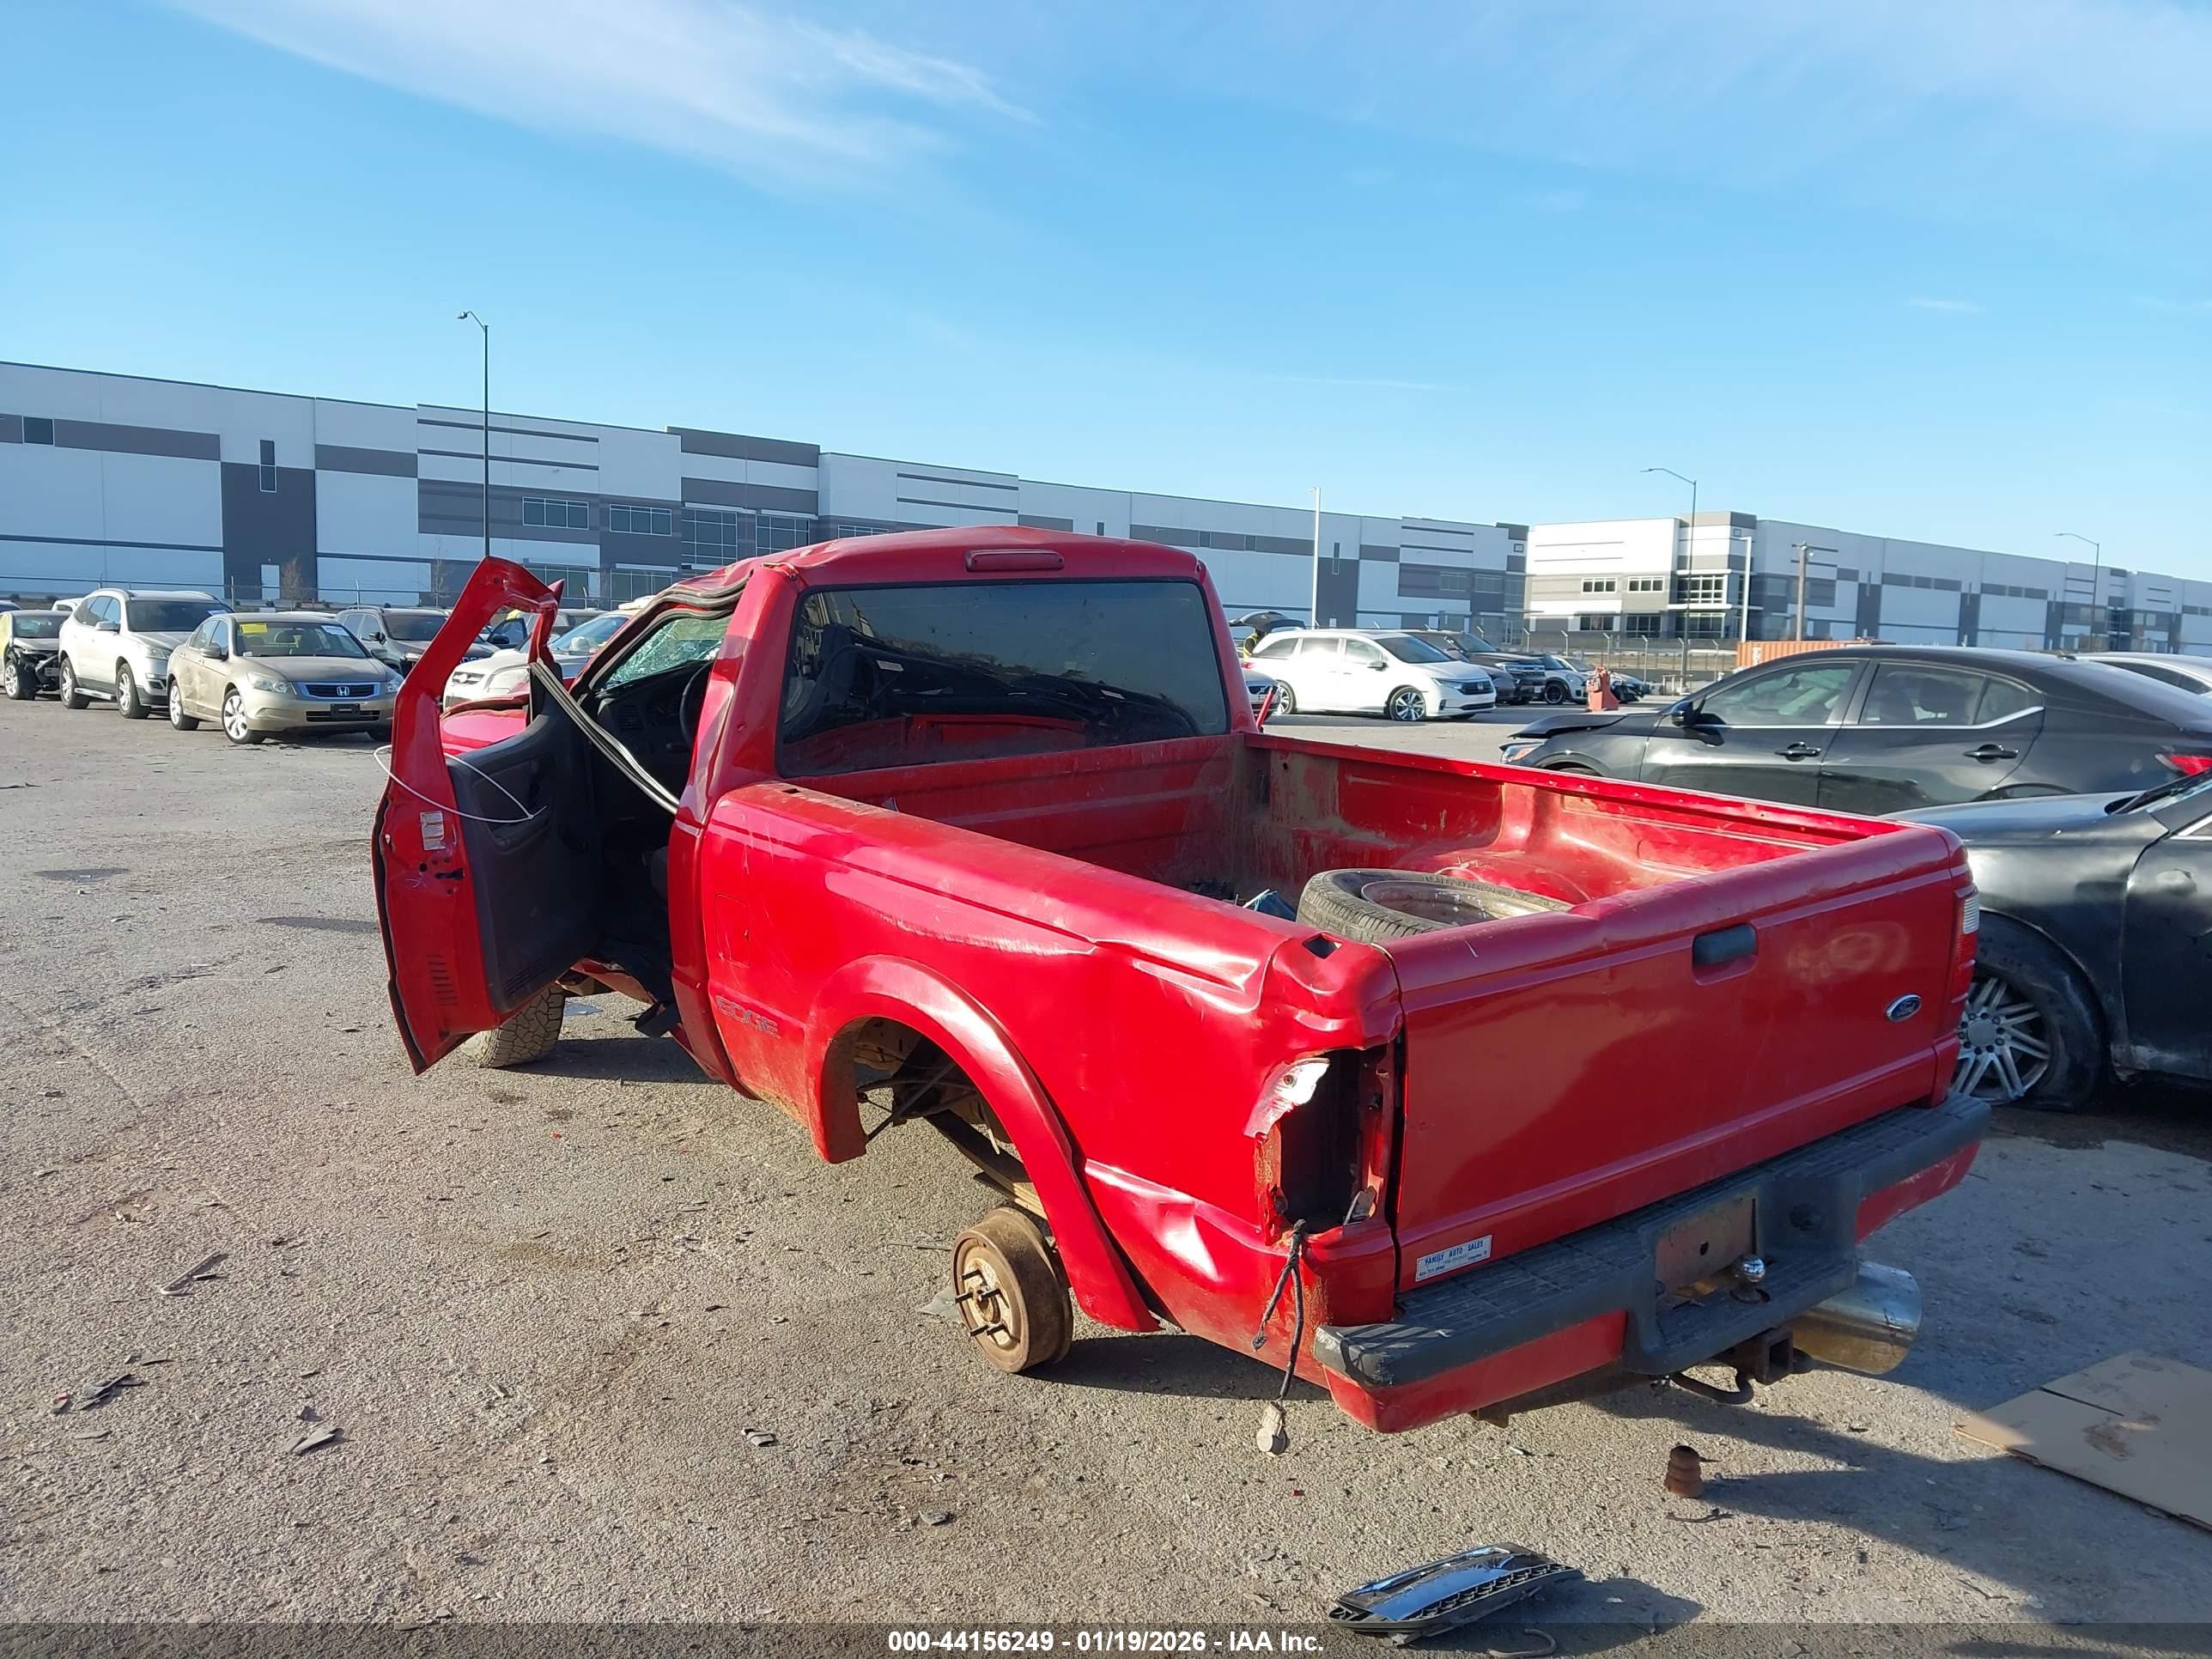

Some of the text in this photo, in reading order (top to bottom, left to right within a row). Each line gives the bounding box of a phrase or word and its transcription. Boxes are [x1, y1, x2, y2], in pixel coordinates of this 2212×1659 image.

[715, 994, 781, 1040] EDGE
[1425, 1252, 1444, 1265] FAMILY
[1449, 1247, 1463, 1258] AUTO
[1468, 1240, 1484, 1251] SALES
